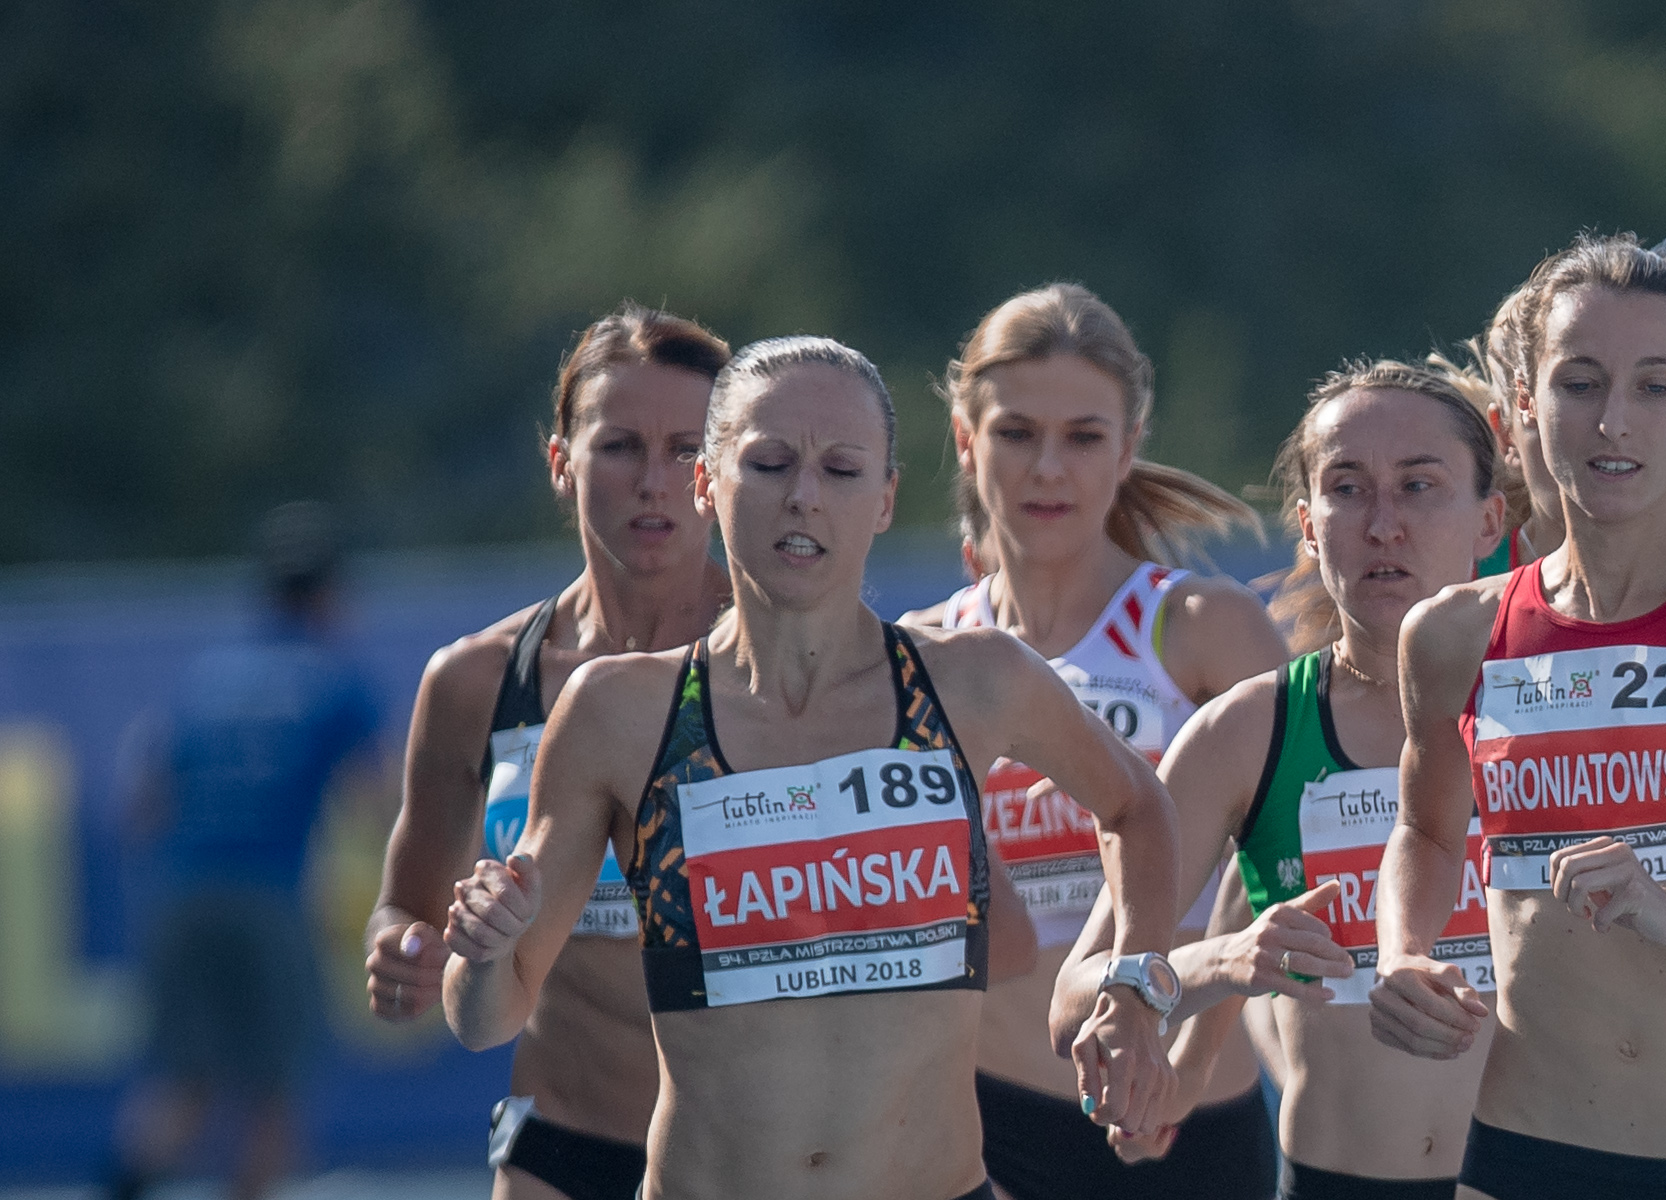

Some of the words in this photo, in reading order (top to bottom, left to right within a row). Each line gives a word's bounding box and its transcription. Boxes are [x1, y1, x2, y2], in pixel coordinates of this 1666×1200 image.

[1493, 676, 1565, 705] lublin
[838, 762, 956, 814] 189
[692, 792, 785, 820] lublin
[1523, 838, 1558, 852] PZLA
[703, 846, 961, 928] ŁAPIŃSKA
[749, 948, 792, 964] PZLA
[795, 933, 910, 959] MISTRZOSTWA
[915, 924, 958, 945] POLSKI
[775, 966, 858, 993] LUBLIN
[865, 958, 922, 983] 2018
